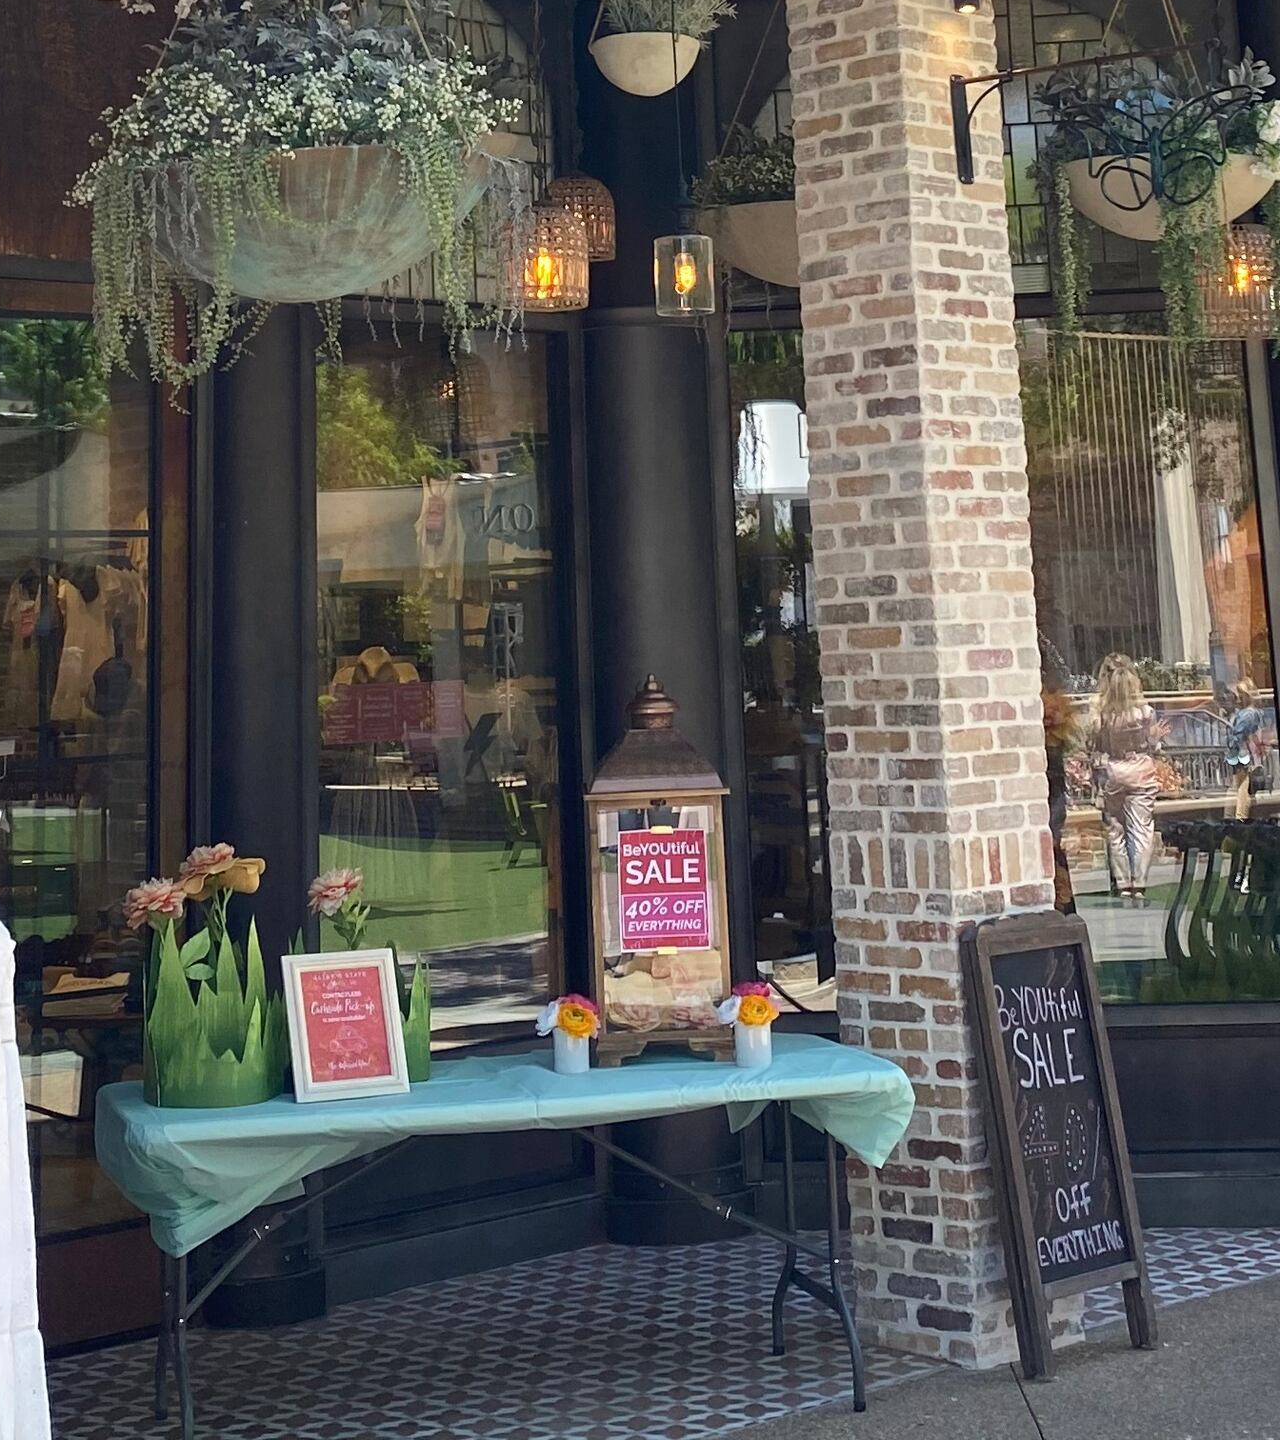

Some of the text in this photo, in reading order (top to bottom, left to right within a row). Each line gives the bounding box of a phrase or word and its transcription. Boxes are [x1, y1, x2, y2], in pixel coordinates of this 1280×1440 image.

[622, 841, 700, 857] BeYOUtiful
[625, 858, 700, 885] SALE
[625, 896, 704, 919] 40% OFF
[627, 919, 701, 932] EVERYTHING
[994, 984, 1083, 1032] BeYOUtiful
[1013, 1027, 1085, 1089] SALE
[1037, 1220, 1125, 1268] EVERYTHING
